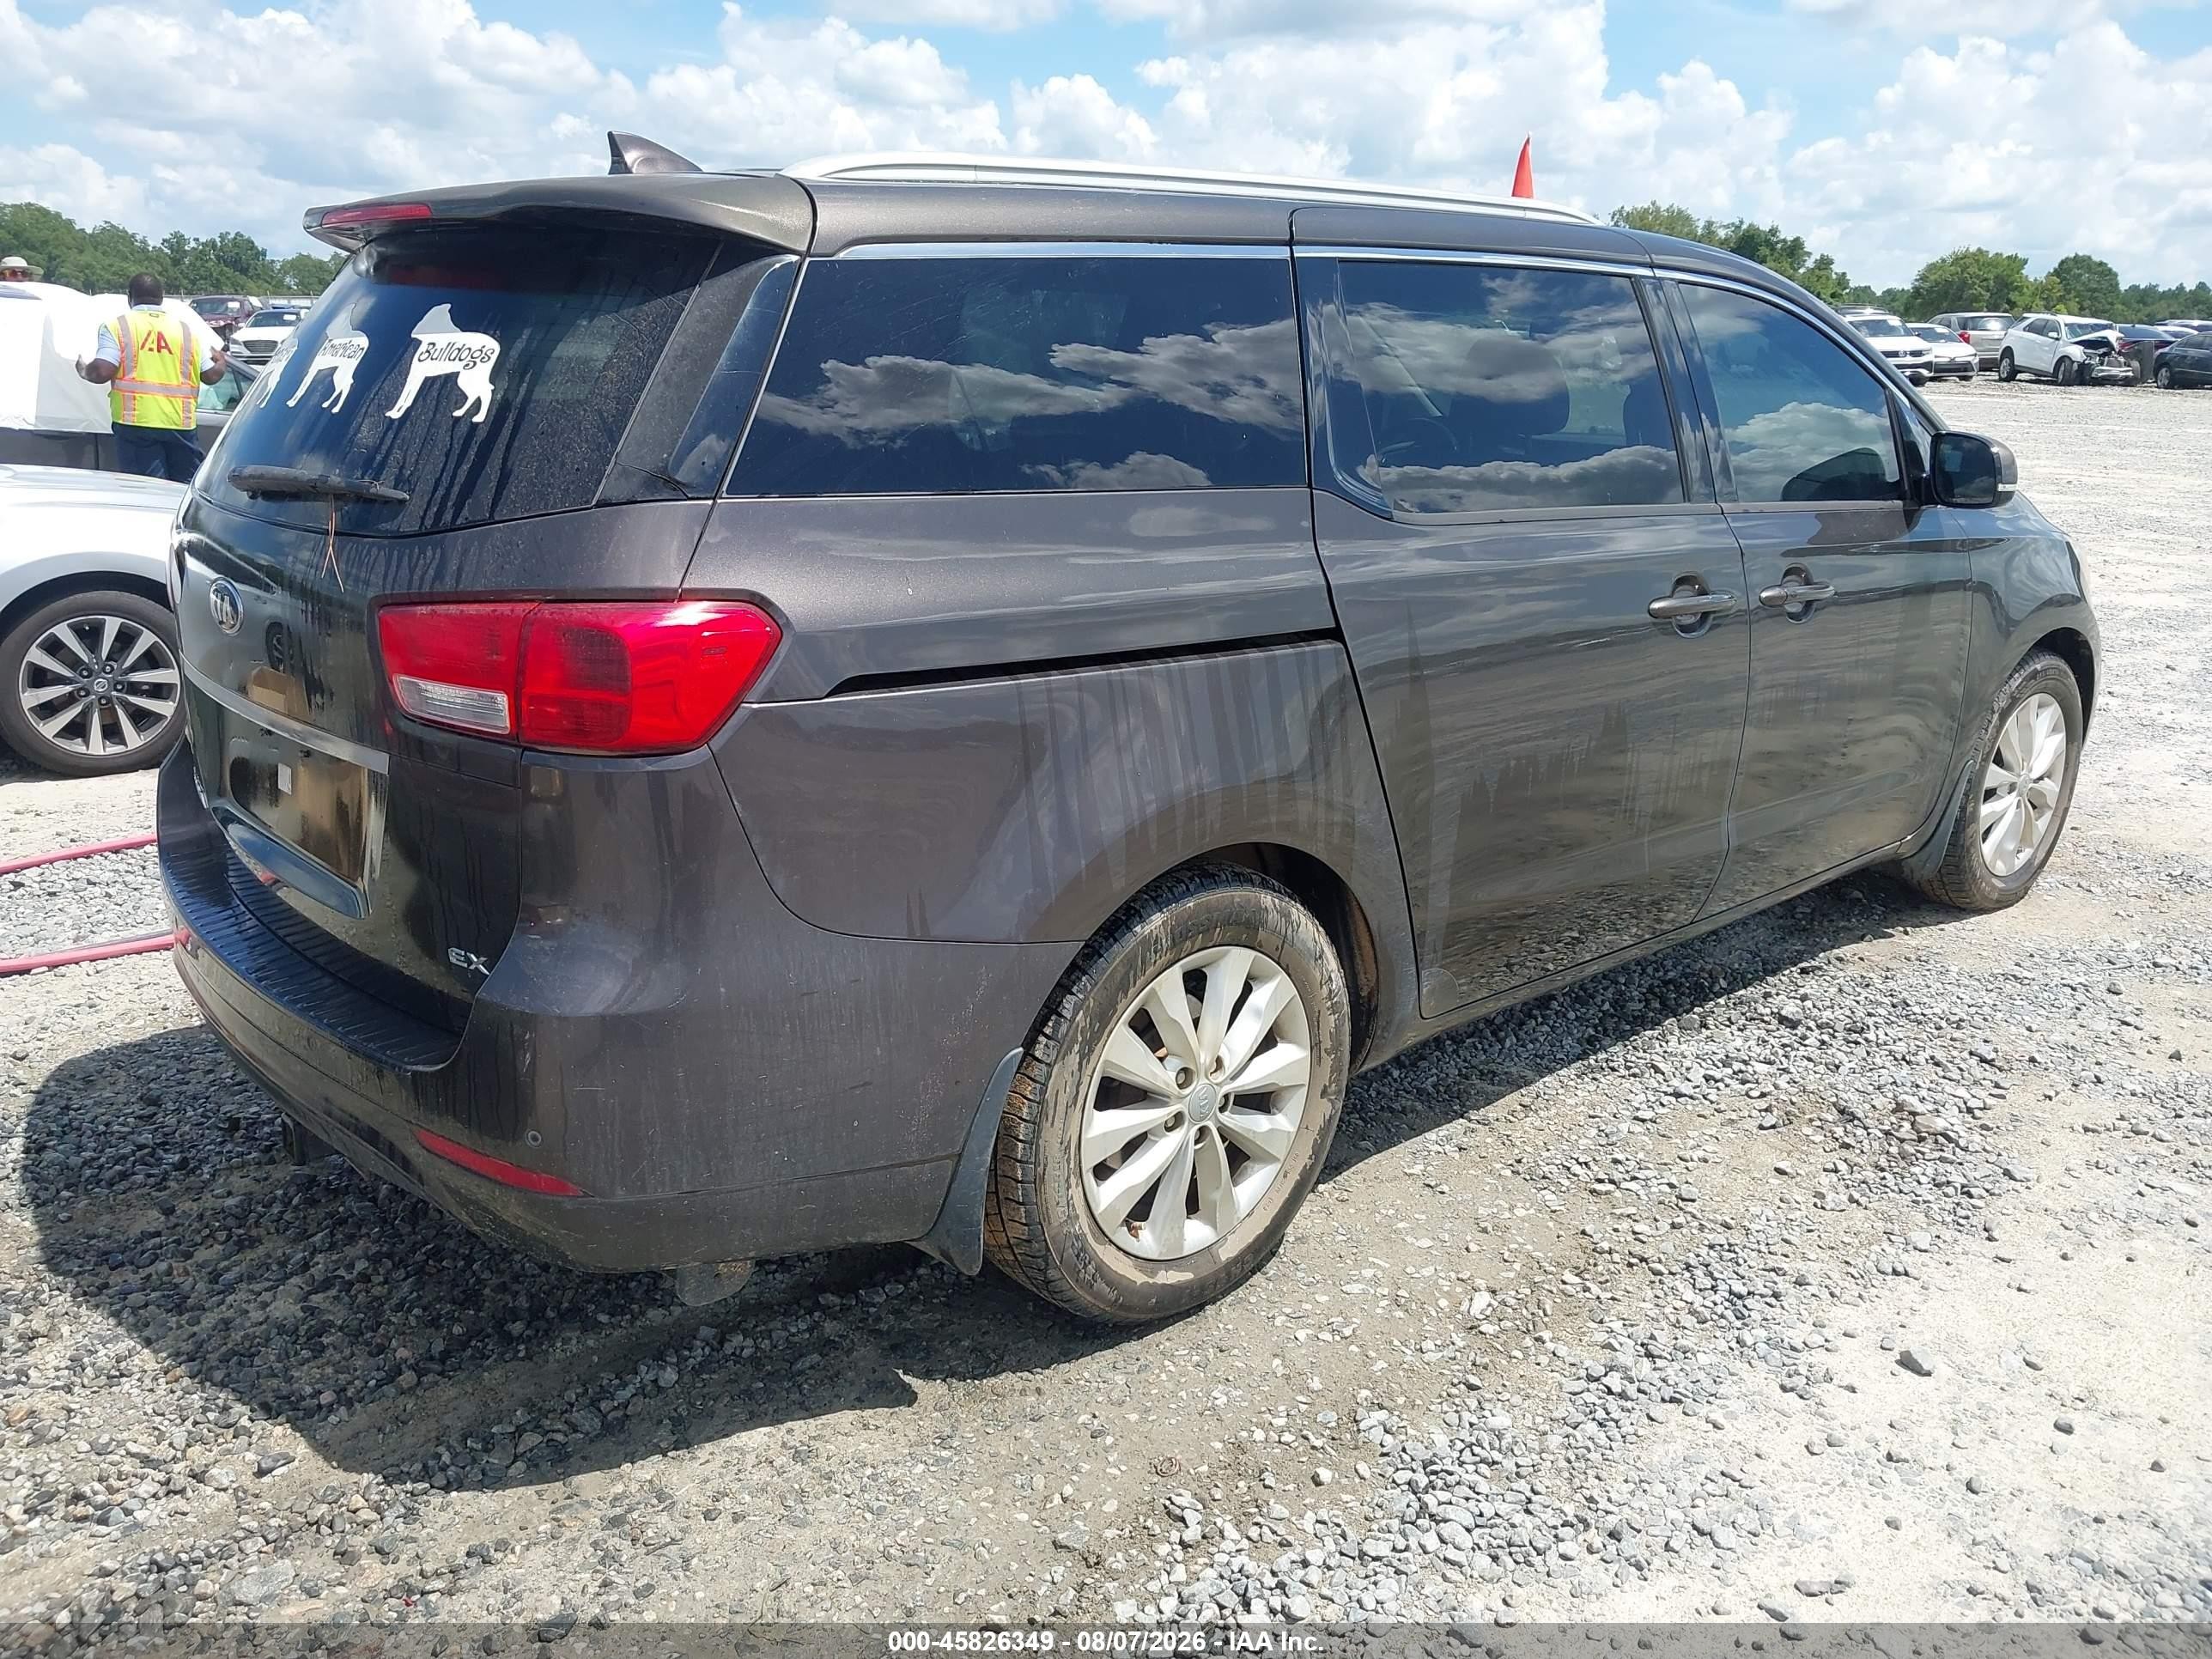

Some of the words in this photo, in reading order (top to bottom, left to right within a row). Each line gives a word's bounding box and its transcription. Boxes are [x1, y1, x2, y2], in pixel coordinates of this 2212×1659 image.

[318, 338, 365, 361] American
[417, 342, 495, 370] Bulldogs
[447, 947, 490, 975] EX
